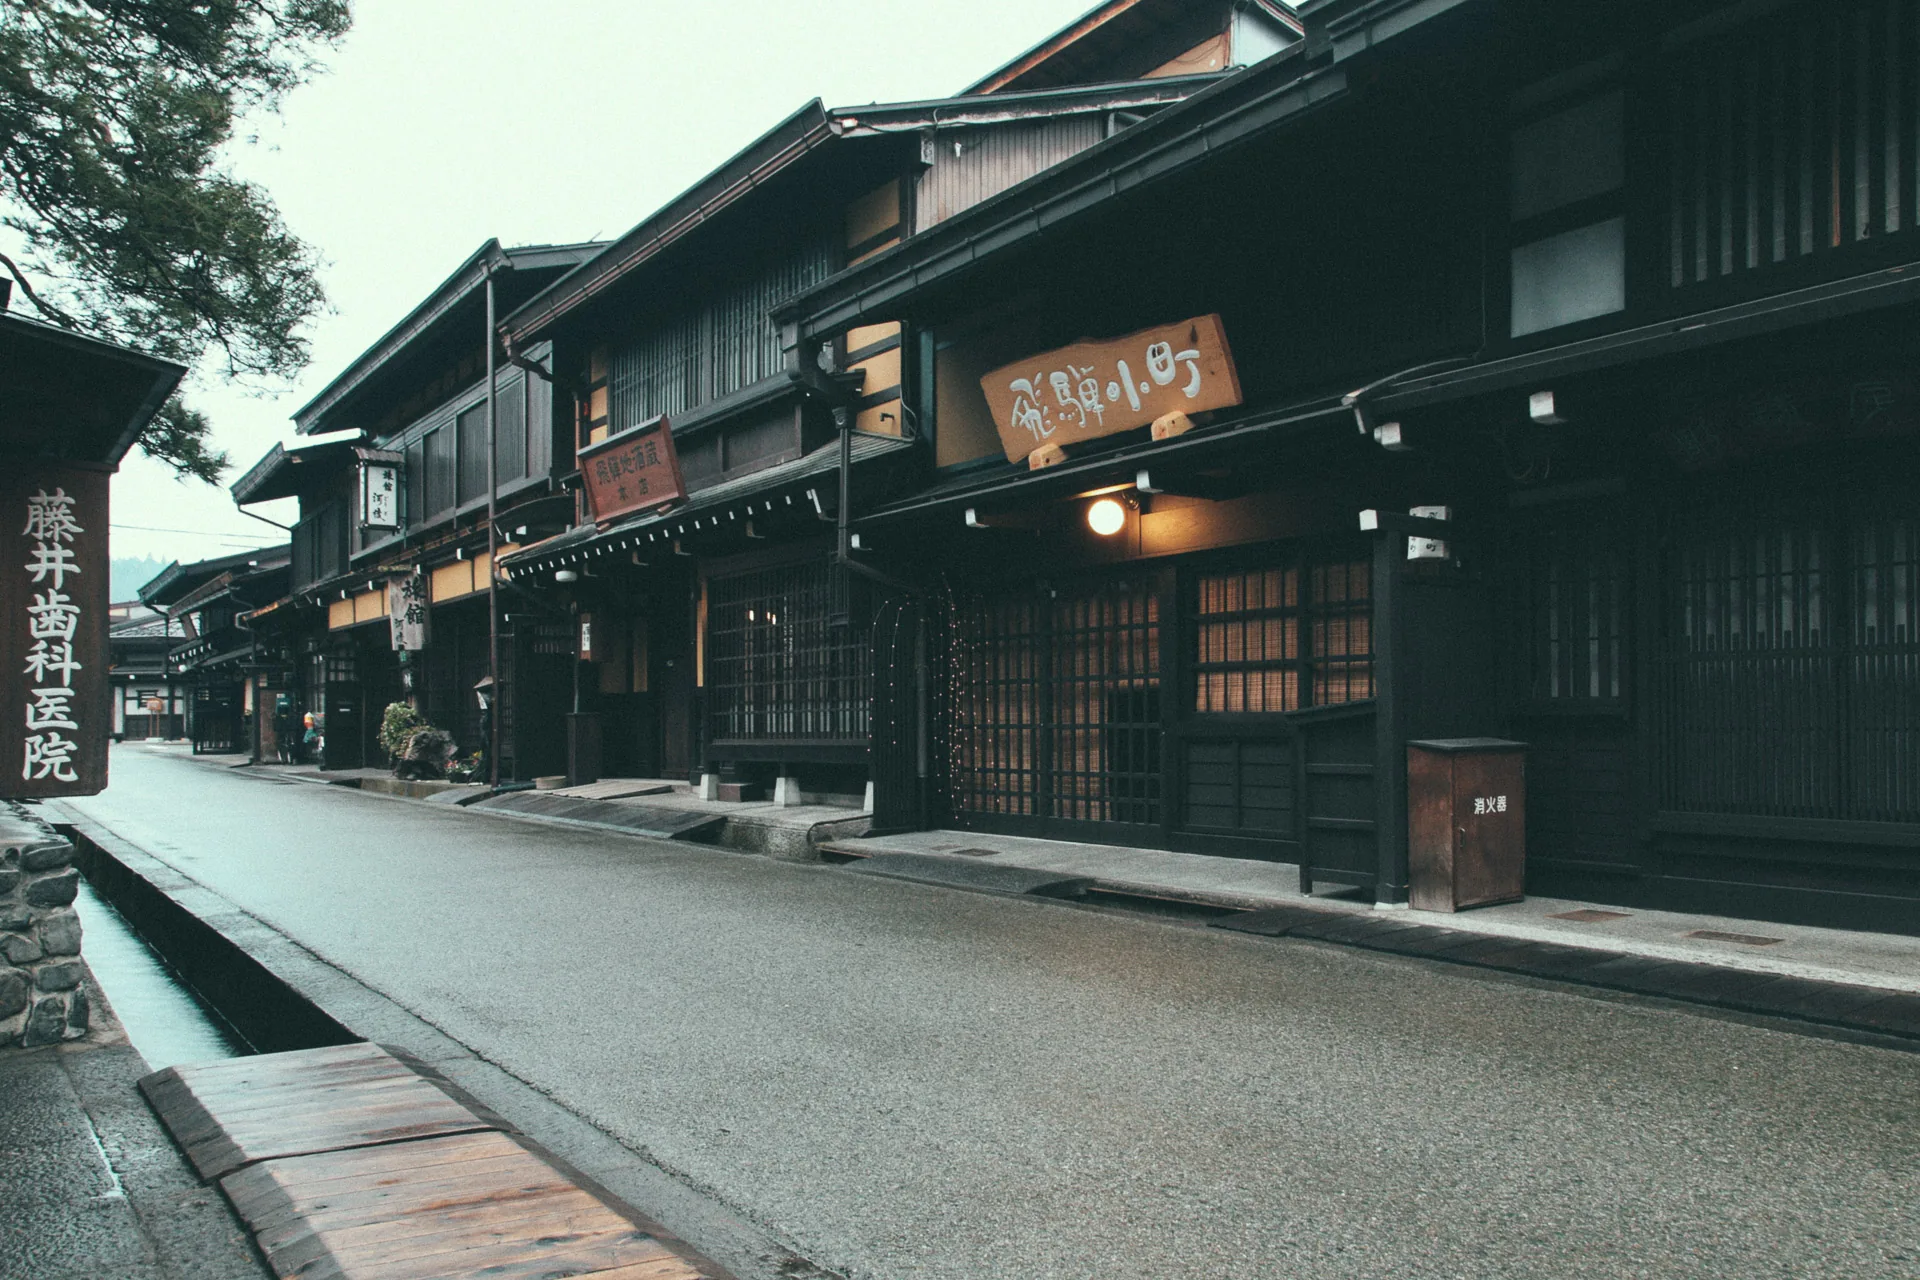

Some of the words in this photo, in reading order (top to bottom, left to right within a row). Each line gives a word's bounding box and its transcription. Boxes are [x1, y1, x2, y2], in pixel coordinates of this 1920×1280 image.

[401, 575, 427, 625] 旅館
[22, 488, 84, 782] 藤井歯科医院
[1474, 795, 1508, 815] 消火器
